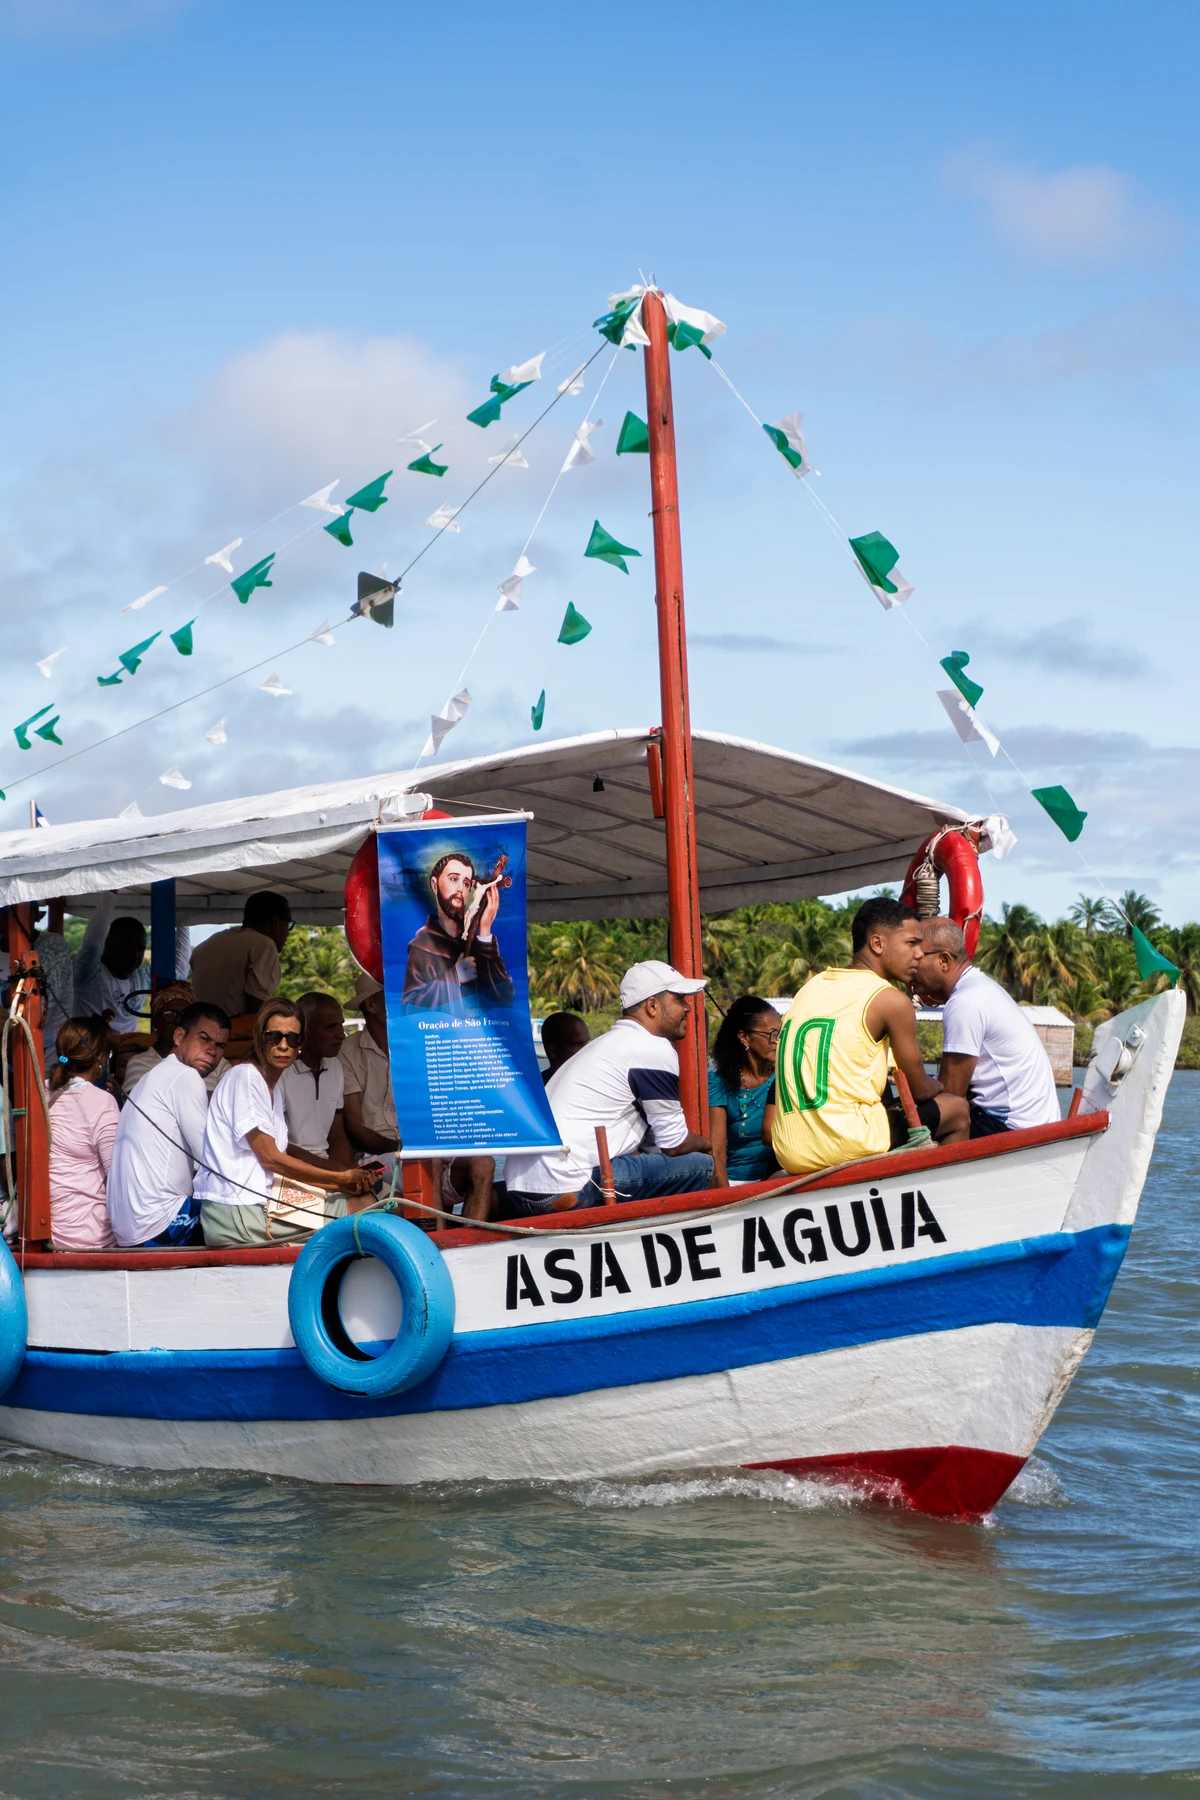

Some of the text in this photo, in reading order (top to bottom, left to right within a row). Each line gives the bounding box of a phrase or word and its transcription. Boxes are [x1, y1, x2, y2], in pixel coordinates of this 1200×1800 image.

[418, 1020, 450, 1030] Oração
[451, 1019, 463, 1028] de
[464, 1018, 482, 1027] São
[777, 1017, 837, 1115] 10
[505, 1241, 631, 1310] ASA
[641, 1225, 721, 1288] DE
